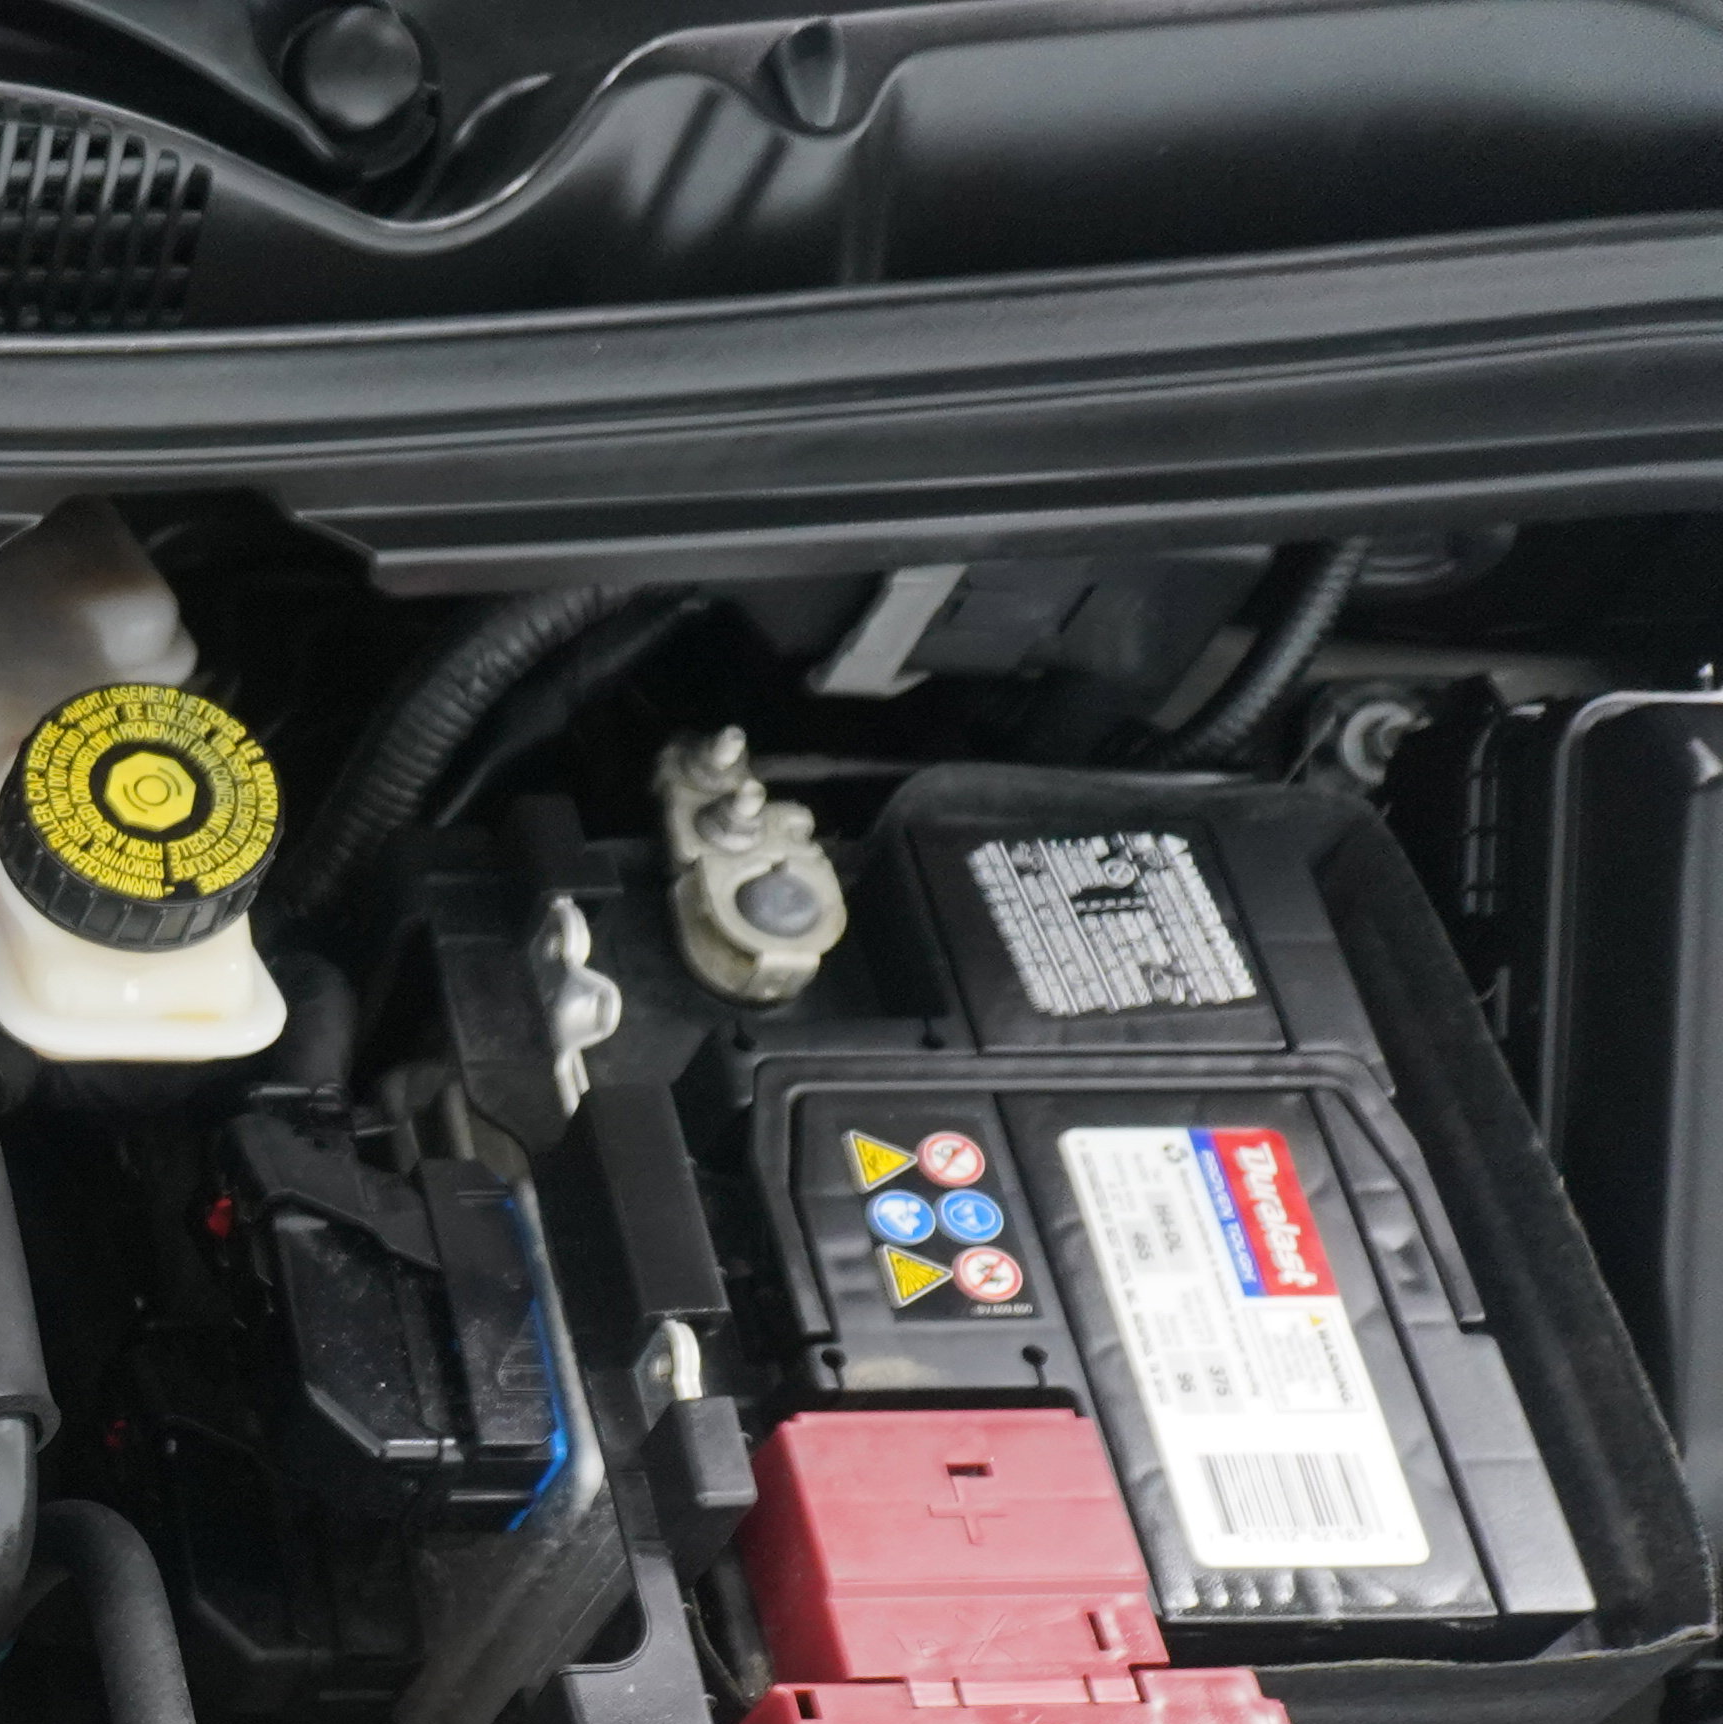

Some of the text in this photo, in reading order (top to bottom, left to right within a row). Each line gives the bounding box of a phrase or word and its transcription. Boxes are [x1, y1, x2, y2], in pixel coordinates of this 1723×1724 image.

[124, 703, 143, 720] DE
[26, 720, 65, 769] BEFORE
[52, 726, 87, 761] FLUID
[25, 771, 47, 800] CAP
[48, 765, 68, 787] DOT
[48, 789, 75, 818] ONLY
[28, 803, 70, 850] FILLER
[59, 815, 93, 847] USE
[108, 831, 128, 851] A
[123, 837, 164, 860] FROM
[1201, 1150, 1236, 1219] PROVEN
[1235, 1141, 1318, 1288] Duralast
[1177, 1372, 1195, 1394] 96
[1209, 1365, 1229, 1396] 375
